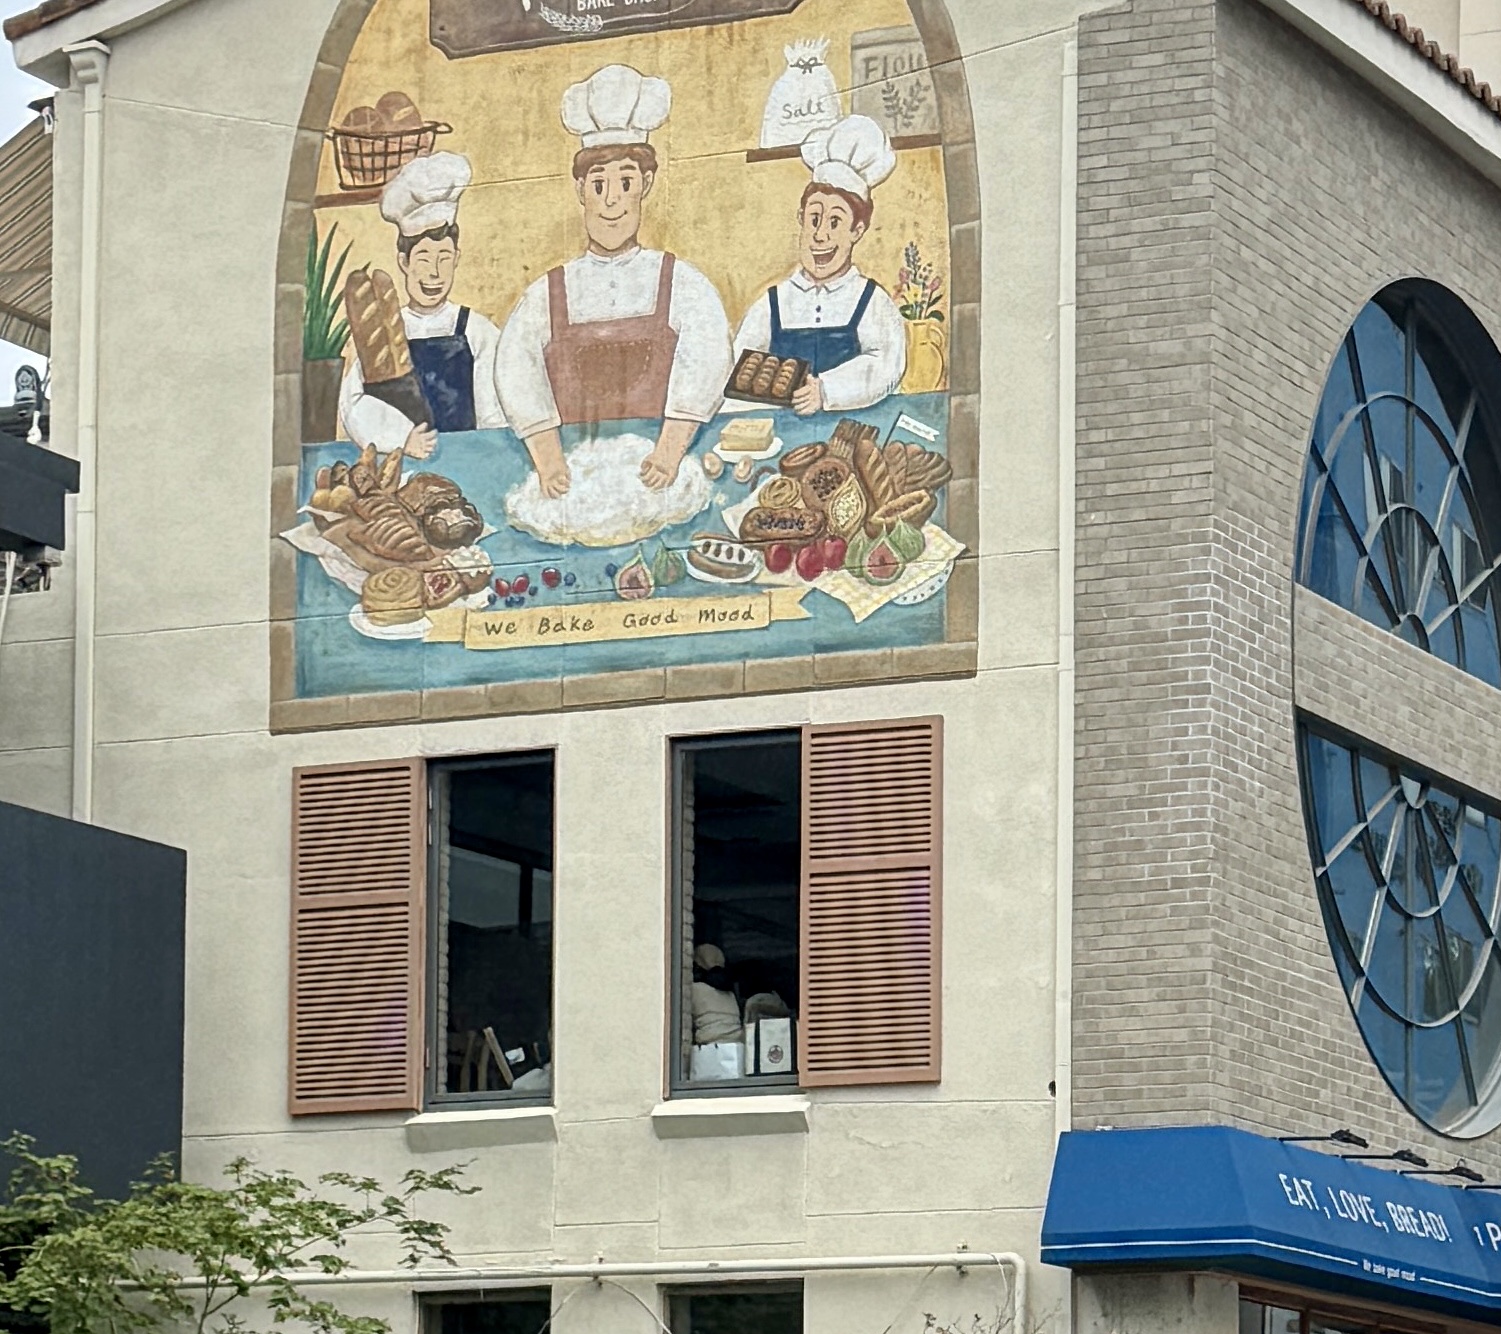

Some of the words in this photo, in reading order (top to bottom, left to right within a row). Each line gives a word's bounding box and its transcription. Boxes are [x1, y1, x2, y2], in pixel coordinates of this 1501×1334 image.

[782, 98, 828, 120] Salt
[485, 620, 517, 636] We
[537, 614, 595, 635] Bake
[622, 609, 679, 629] Good
[1278, 1173, 1330, 1219] EAT,
[1327, 1186, 1390, 1233] LOVE,
[1386, 1201, 1452, 1243] BREAD!
